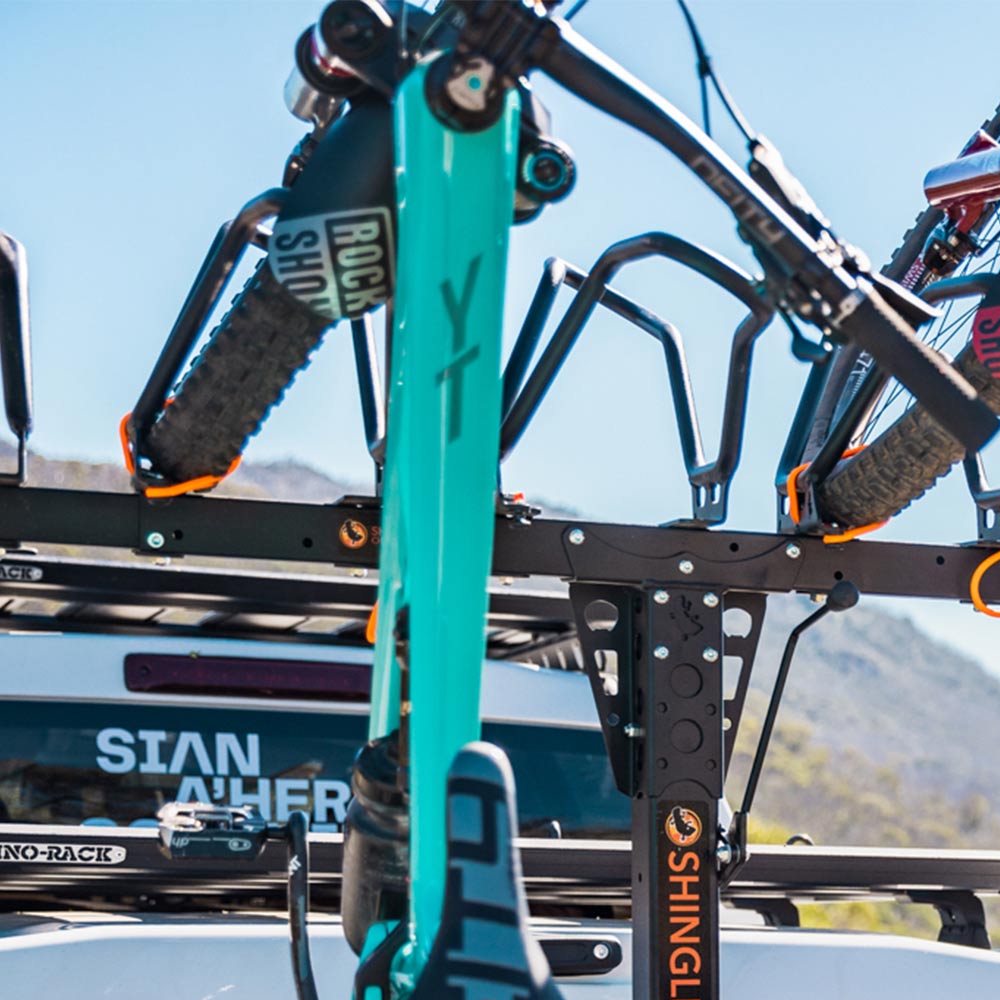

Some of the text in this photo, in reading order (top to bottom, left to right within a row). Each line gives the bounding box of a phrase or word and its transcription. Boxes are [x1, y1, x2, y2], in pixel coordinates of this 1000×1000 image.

[331, 220, 387, 313] ROCK
[436, 253, 483, 444] YT
[96, 727, 261, 776] SIAN
